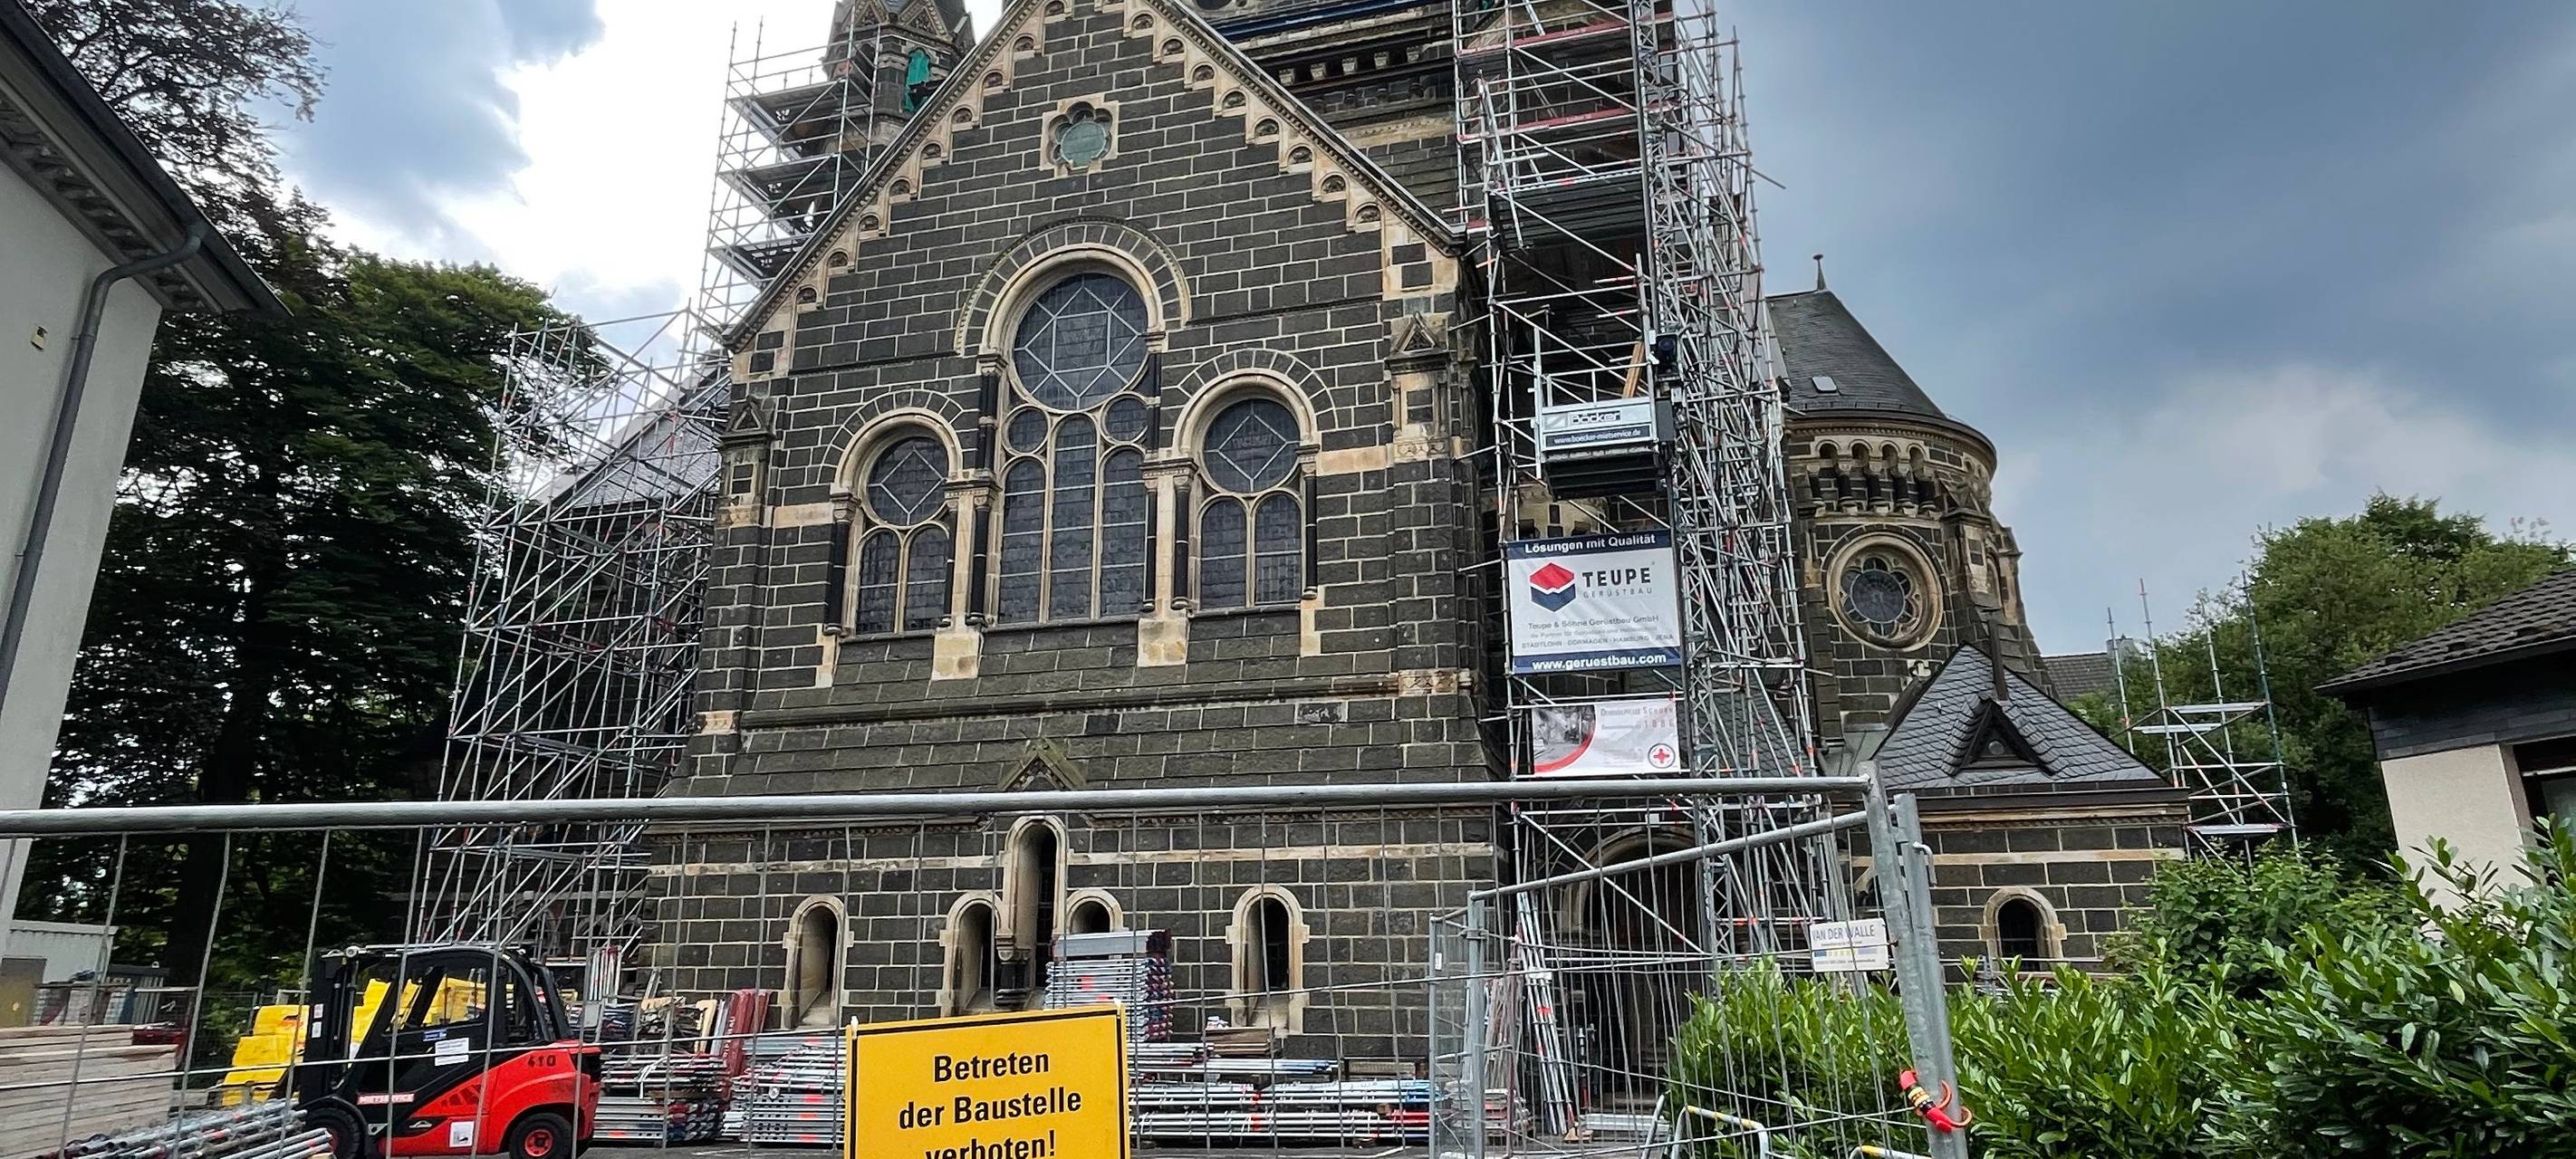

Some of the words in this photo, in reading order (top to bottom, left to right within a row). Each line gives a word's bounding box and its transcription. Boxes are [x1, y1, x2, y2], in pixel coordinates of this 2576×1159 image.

[1524, 540, 1583, 554] Lösungen
[1586, 538, 1606, 549] mit
[1608, 533, 1657, 547] Qualität
[1581, 567, 1651, 589] TEUPE
[1582, 588, 1653, 599] GERÜSTBAU
[1632, 615, 1659, 624] GmbH
[1532, 653, 1668, 671] www.geruestbau.com
[1812, 929, 1826, 941] VAN
[1828, 928, 1843, 939] DER
[933, 1051, 1050, 1083] Betreten
[899, 1101, 946, 1130] der
[954, 1087, 1082, 1124] Baustelle
